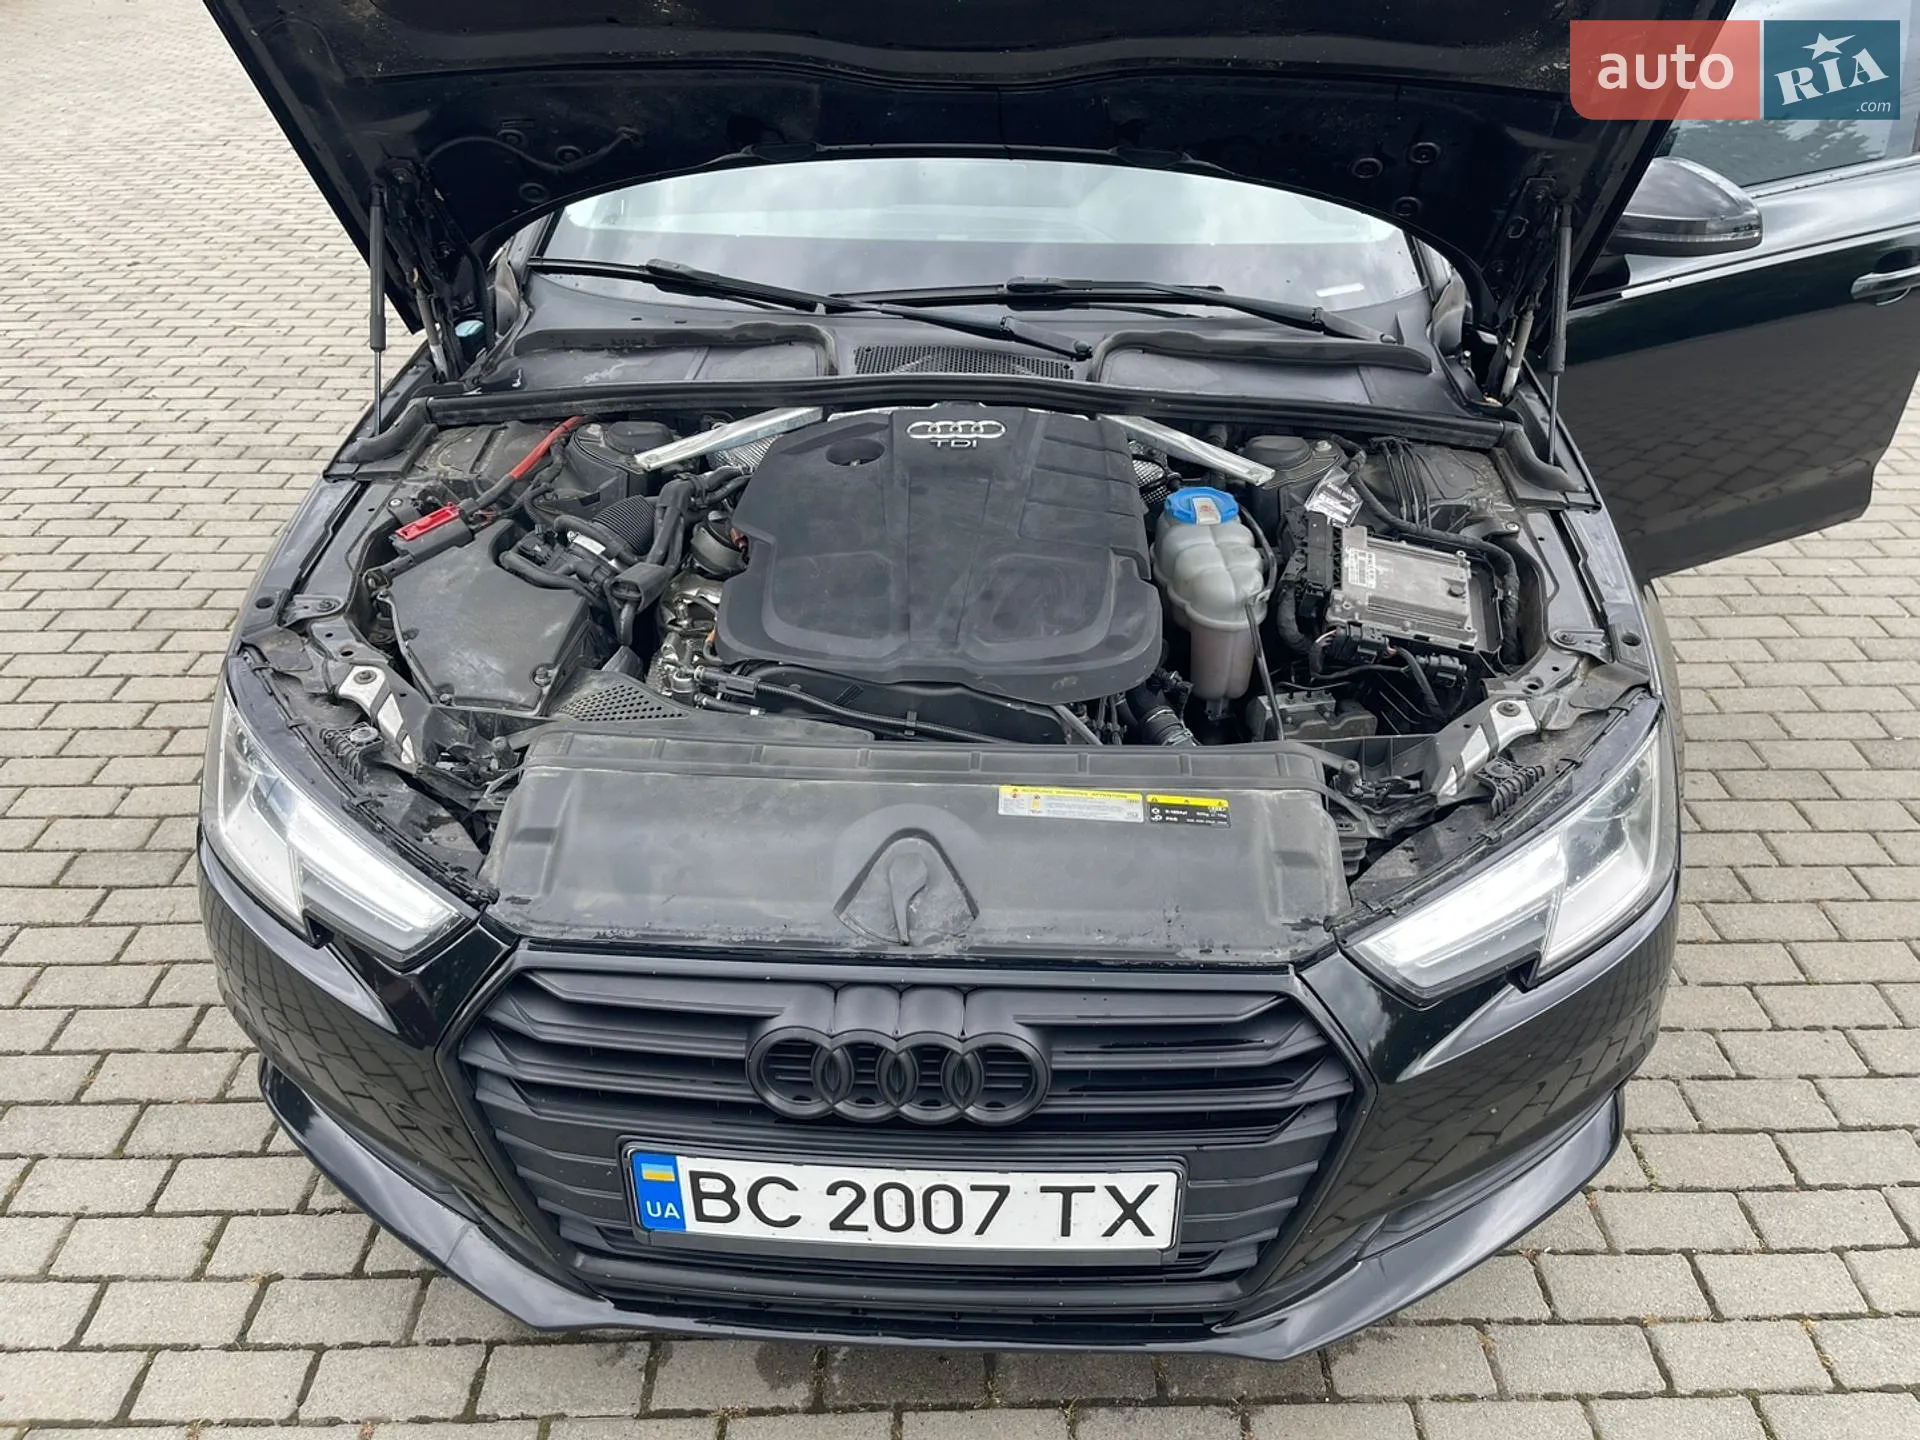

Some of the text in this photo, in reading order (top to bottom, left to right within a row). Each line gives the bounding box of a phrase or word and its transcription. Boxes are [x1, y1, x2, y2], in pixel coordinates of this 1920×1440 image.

[930, 439, 978, 448] TDI
[647, 1200, 680, 1219] UA
[688, 1170, 1160, 1237] BC 2007 TX
